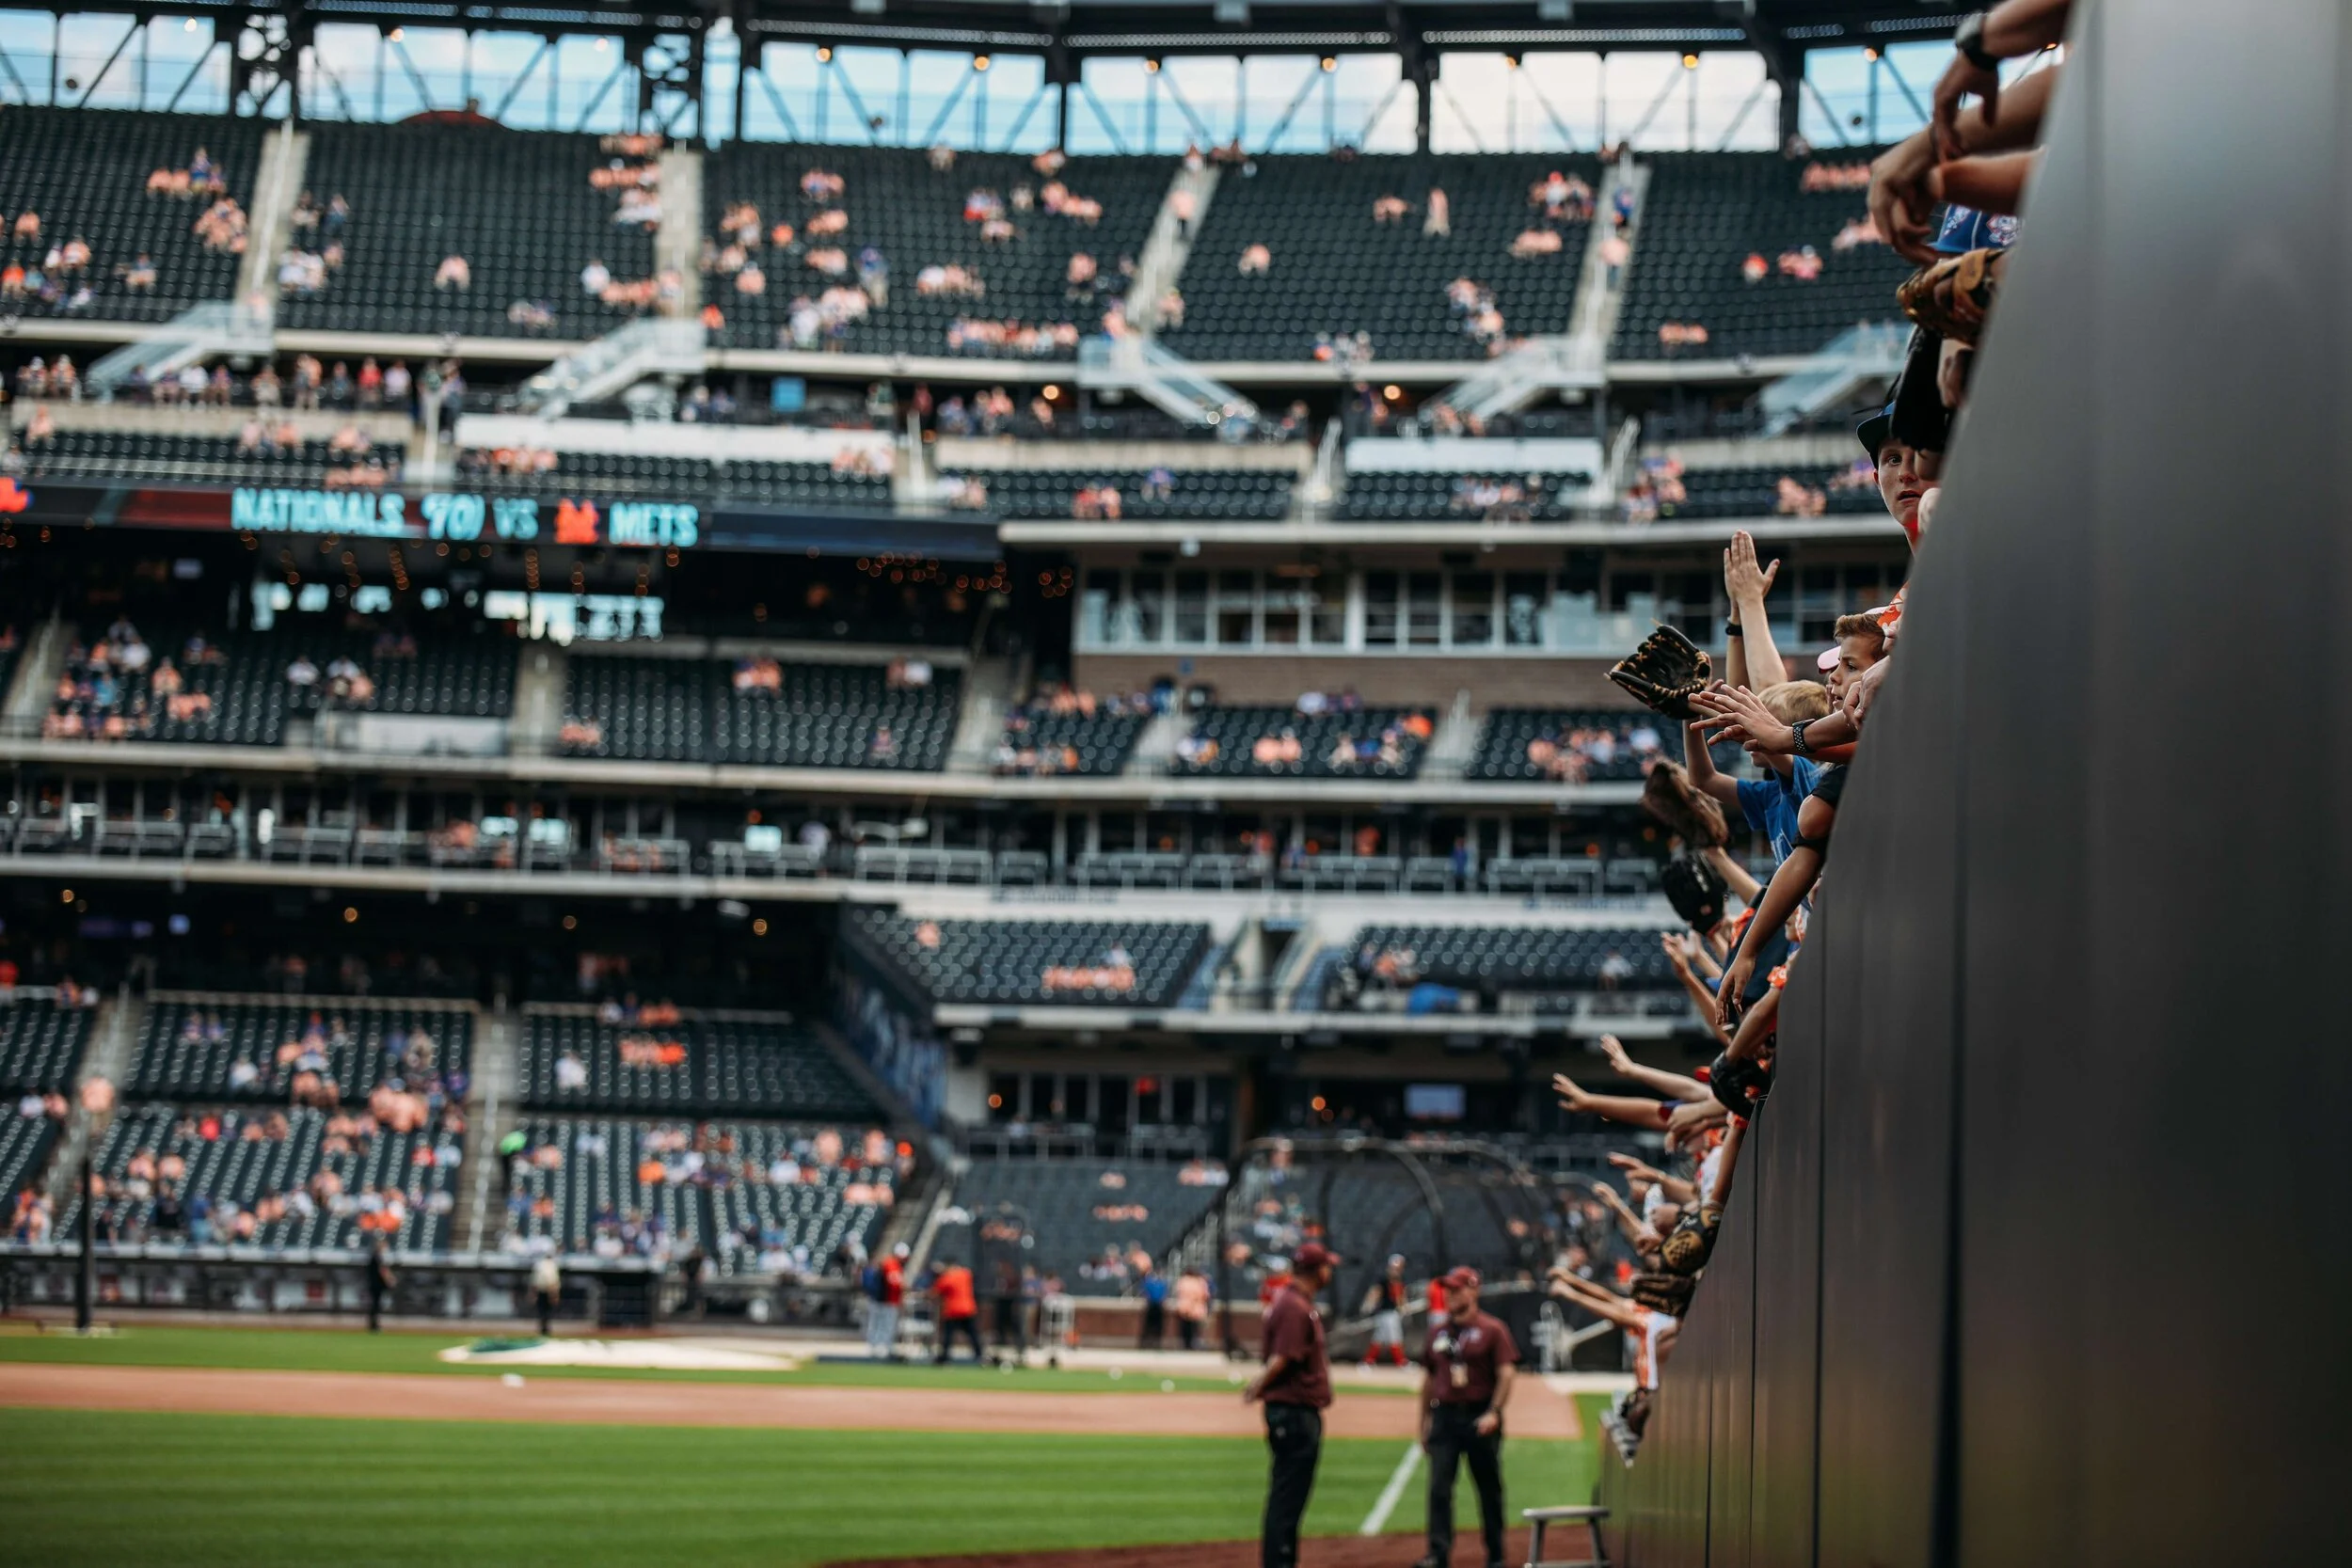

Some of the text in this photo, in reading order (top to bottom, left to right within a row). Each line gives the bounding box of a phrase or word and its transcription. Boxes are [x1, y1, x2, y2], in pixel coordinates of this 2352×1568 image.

[231, 487, 406, 537] NATIONALS
[492, 497, 539, 540] VS
[609, 501, 699, 547] METS
